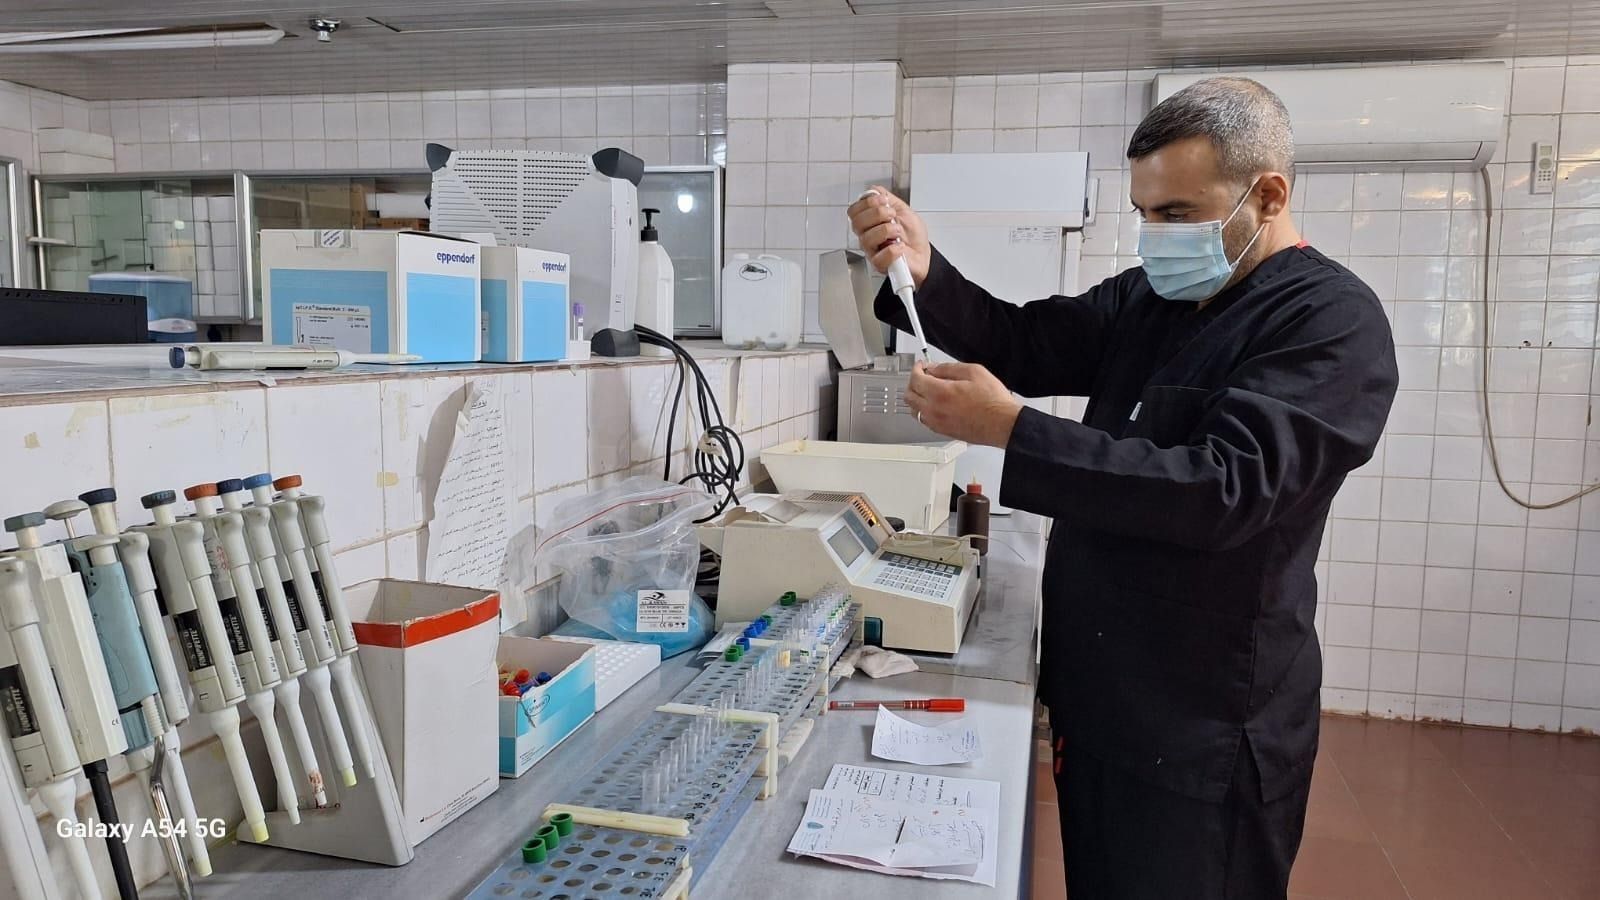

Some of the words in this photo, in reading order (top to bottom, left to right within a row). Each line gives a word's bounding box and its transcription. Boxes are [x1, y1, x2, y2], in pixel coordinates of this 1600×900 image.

[437, 252, 475, 264] eppendorf
[542, 261, 566, 272] eppendorf
[191, 629, 208, 666] FINNPIPETTE
[12, 687, 33, 732] FINNPIPETTE
